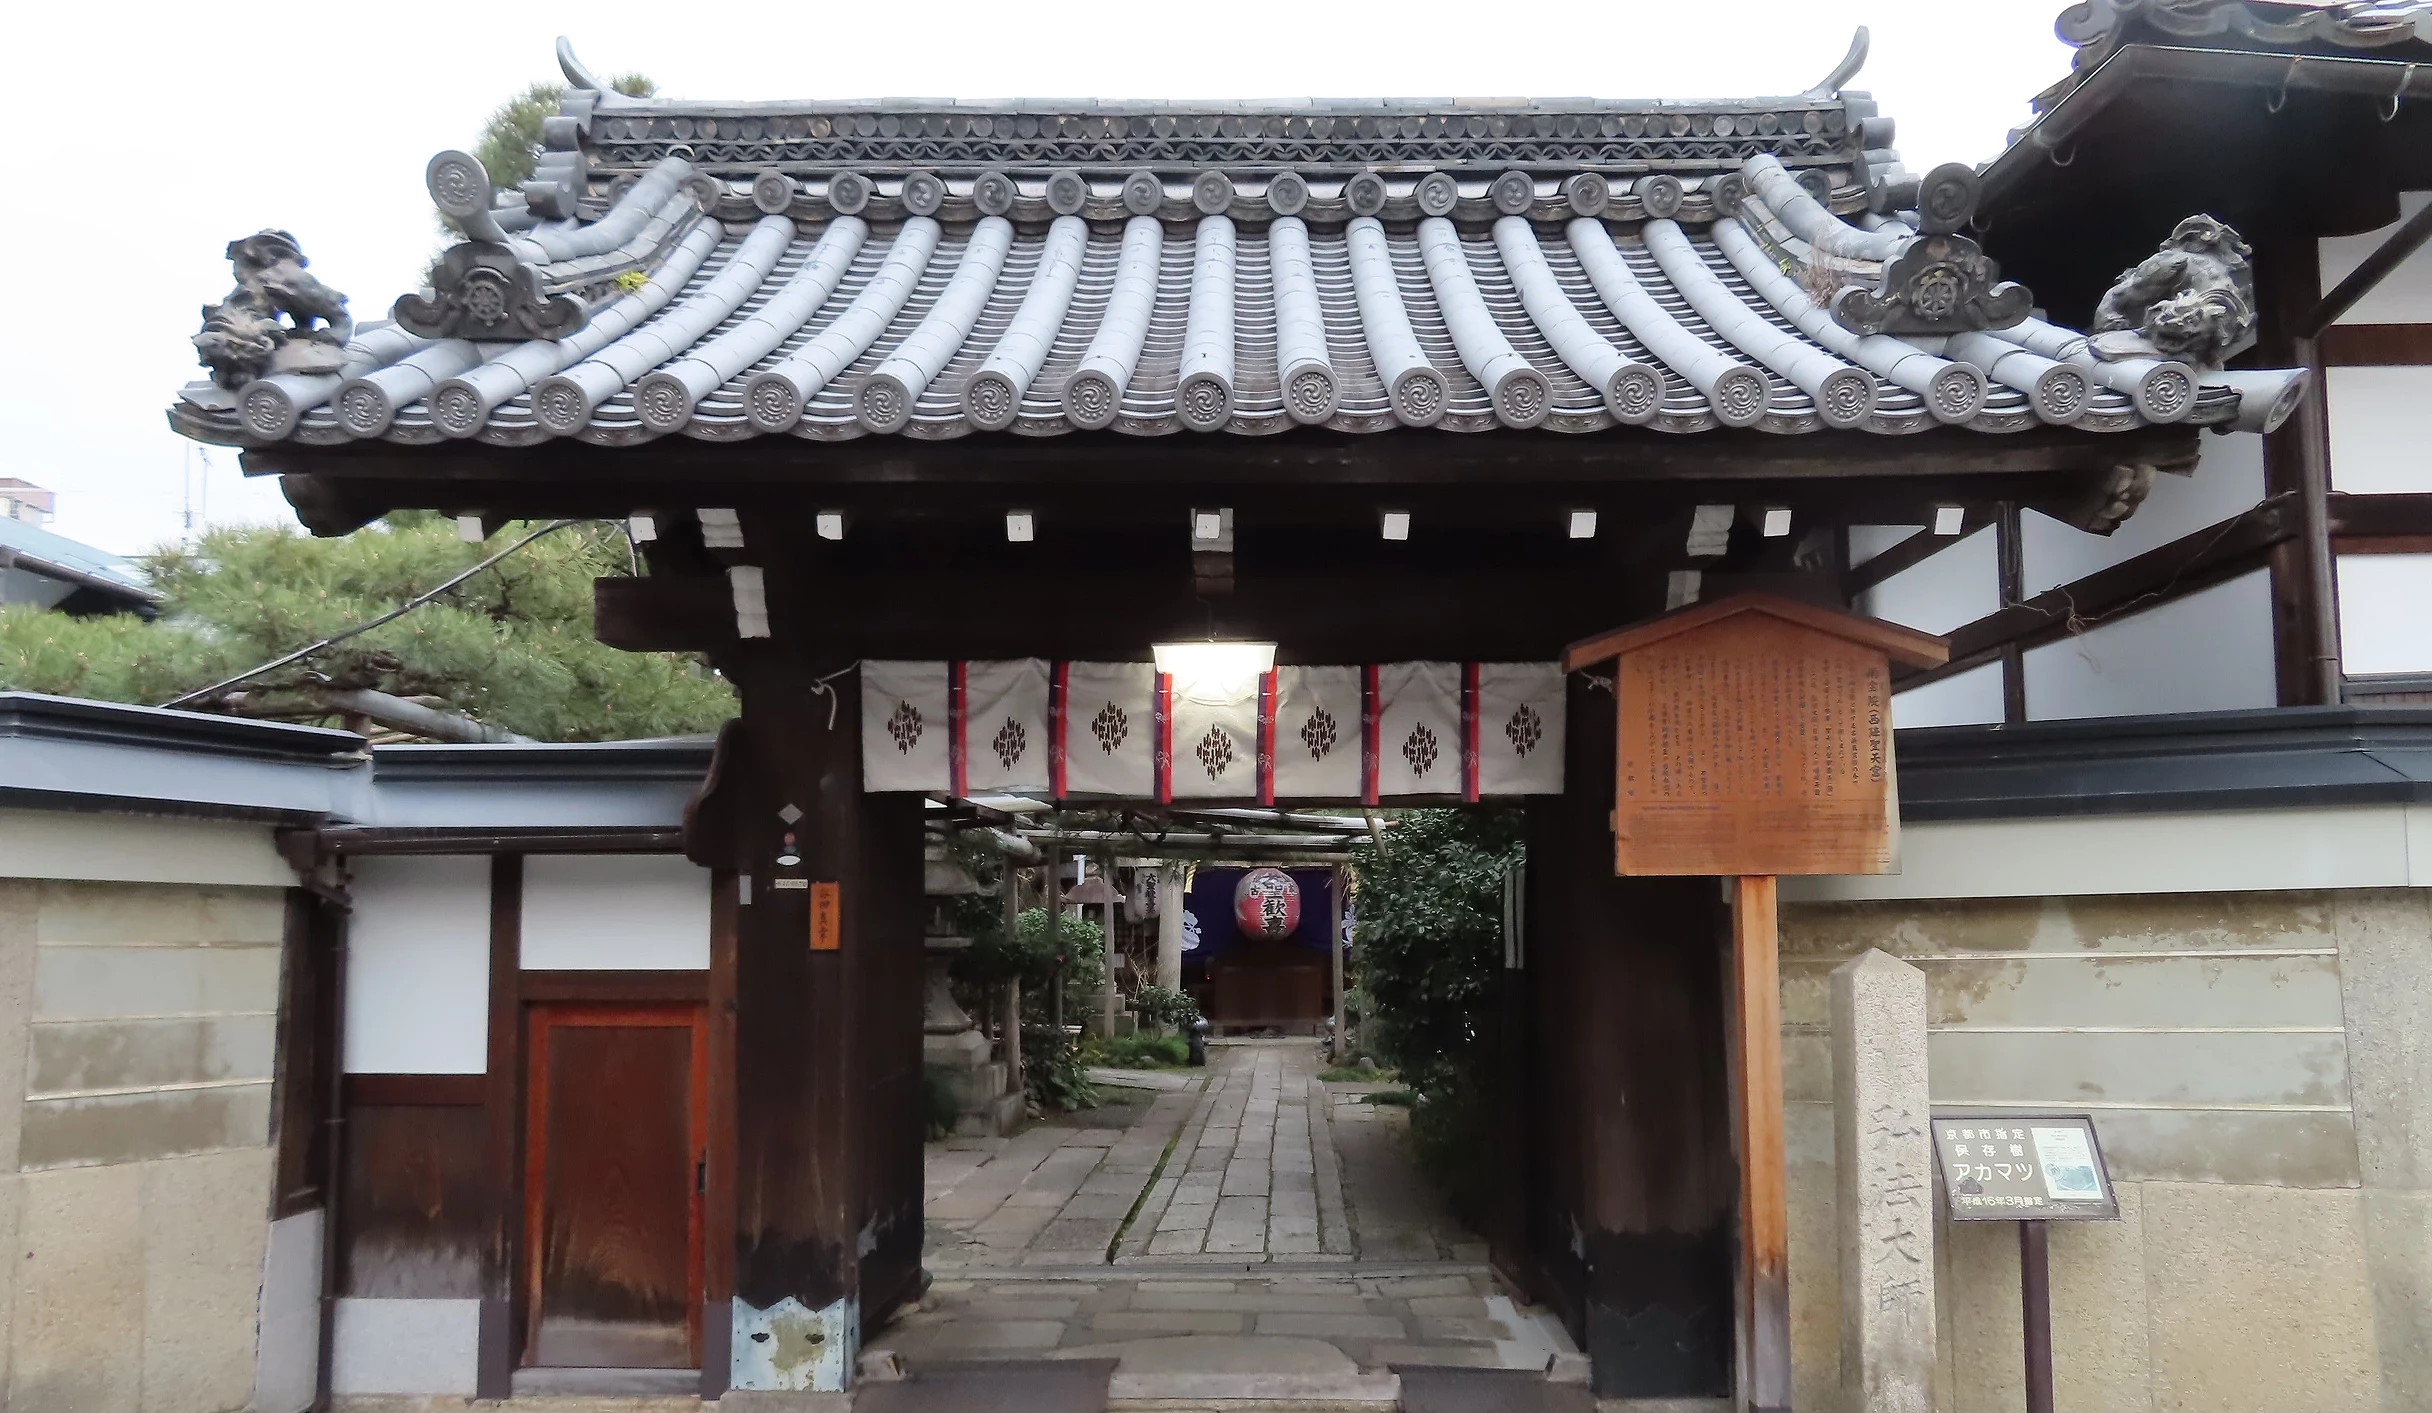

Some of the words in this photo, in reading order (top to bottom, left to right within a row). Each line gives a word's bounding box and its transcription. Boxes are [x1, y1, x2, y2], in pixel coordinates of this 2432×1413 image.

[1945, 1127, 2026, 1140] 京都市指定
[1954, 1144, 2024, 1157] 保存樹
[1952, 1163, 2033, 1182] アカマツ
[1868, 1103, 1925, 1325] 弘法大師
